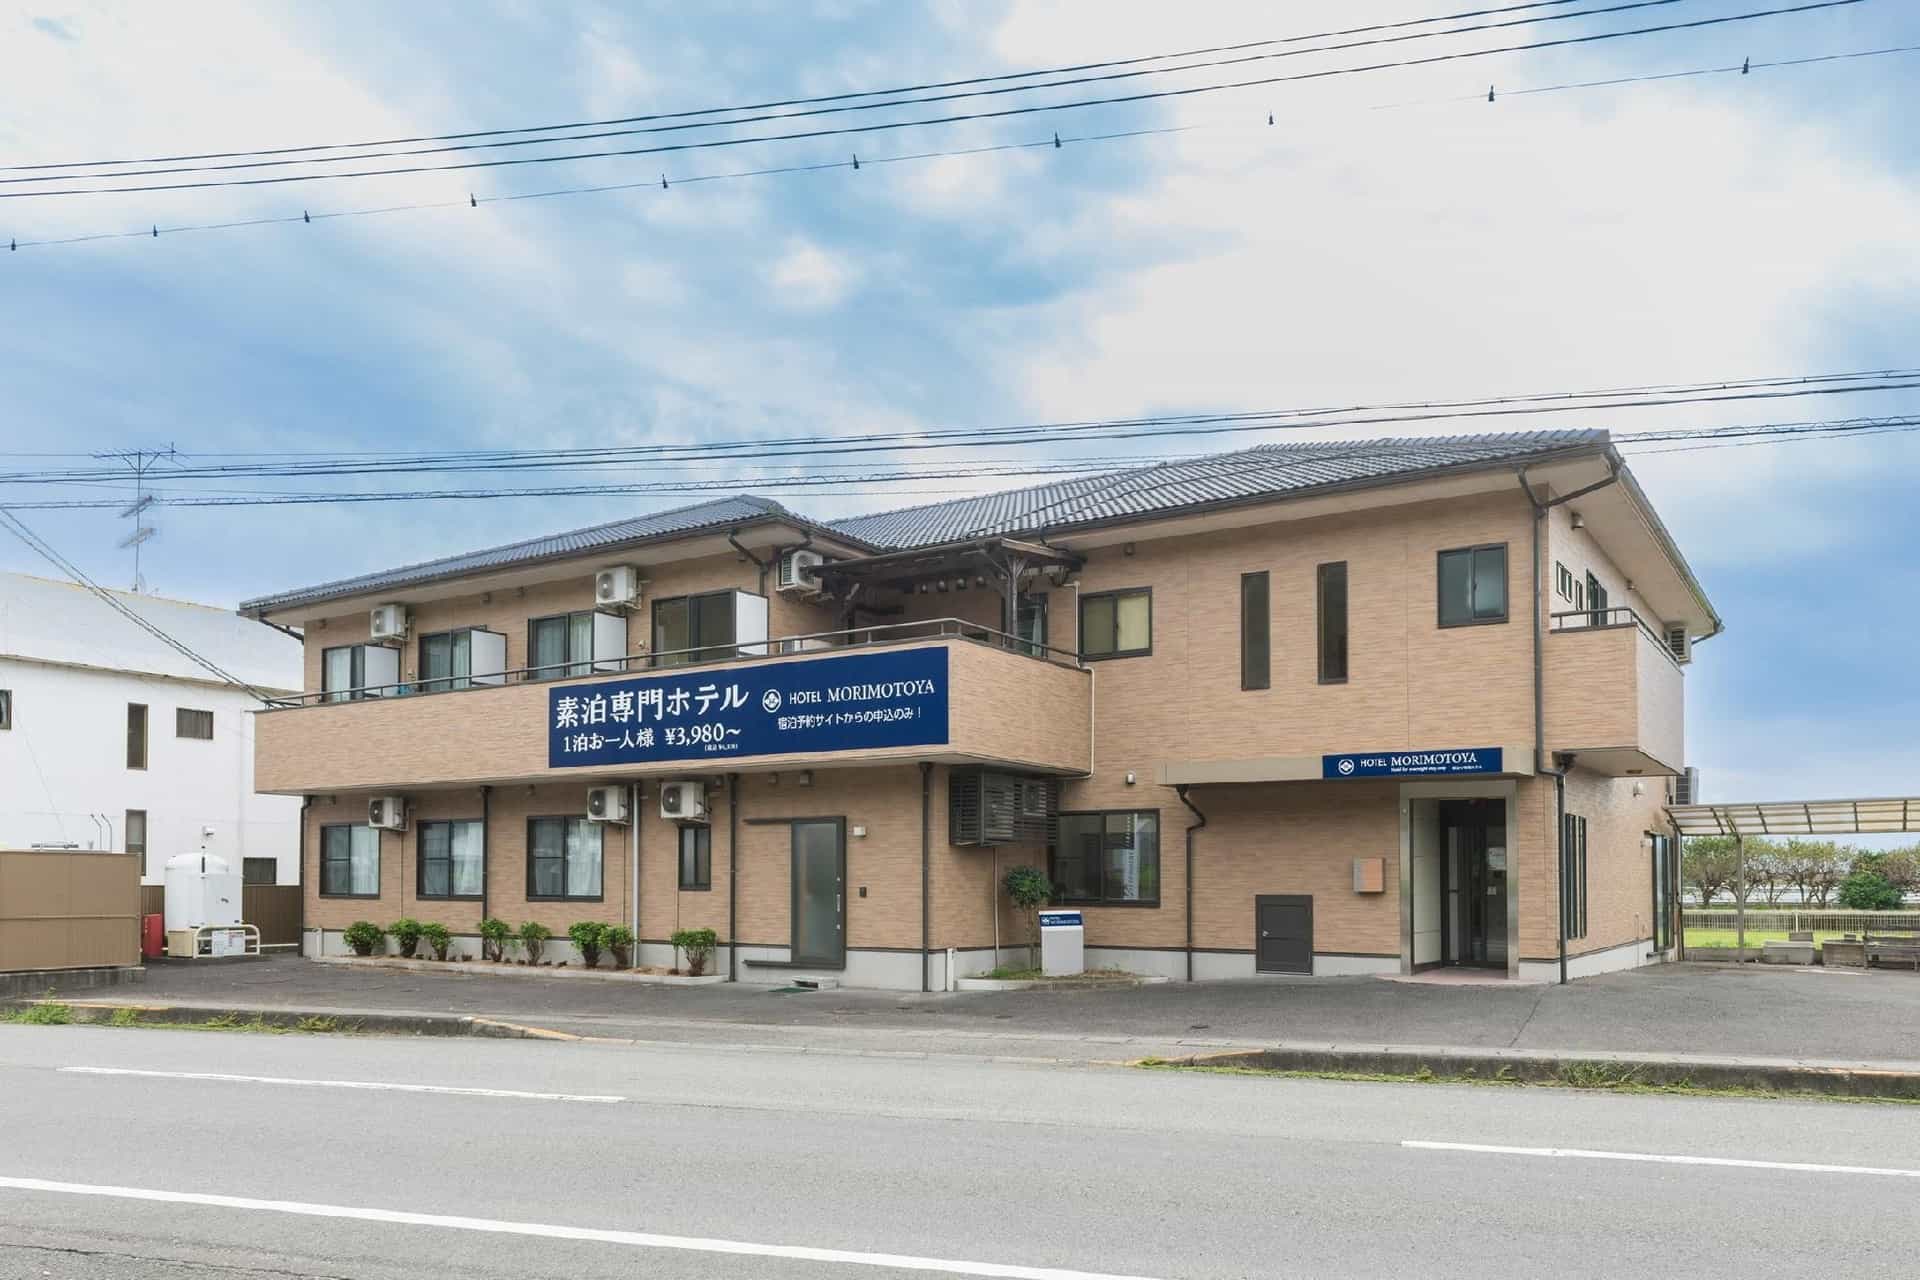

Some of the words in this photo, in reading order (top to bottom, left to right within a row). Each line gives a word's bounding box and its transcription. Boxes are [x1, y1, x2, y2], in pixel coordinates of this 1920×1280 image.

[789, 691, 822, 705] HOTEL
[827, 679, 935, 703] MORIMOTOYA
[555, 683, 750, 729] 素泊専門ホテル
[563, 728, 655, 753] 1泊お一人様
[1360, 758, 1387, 768] HOTEL
[1391, 752, 1477, 767] MORIMOTOYA
